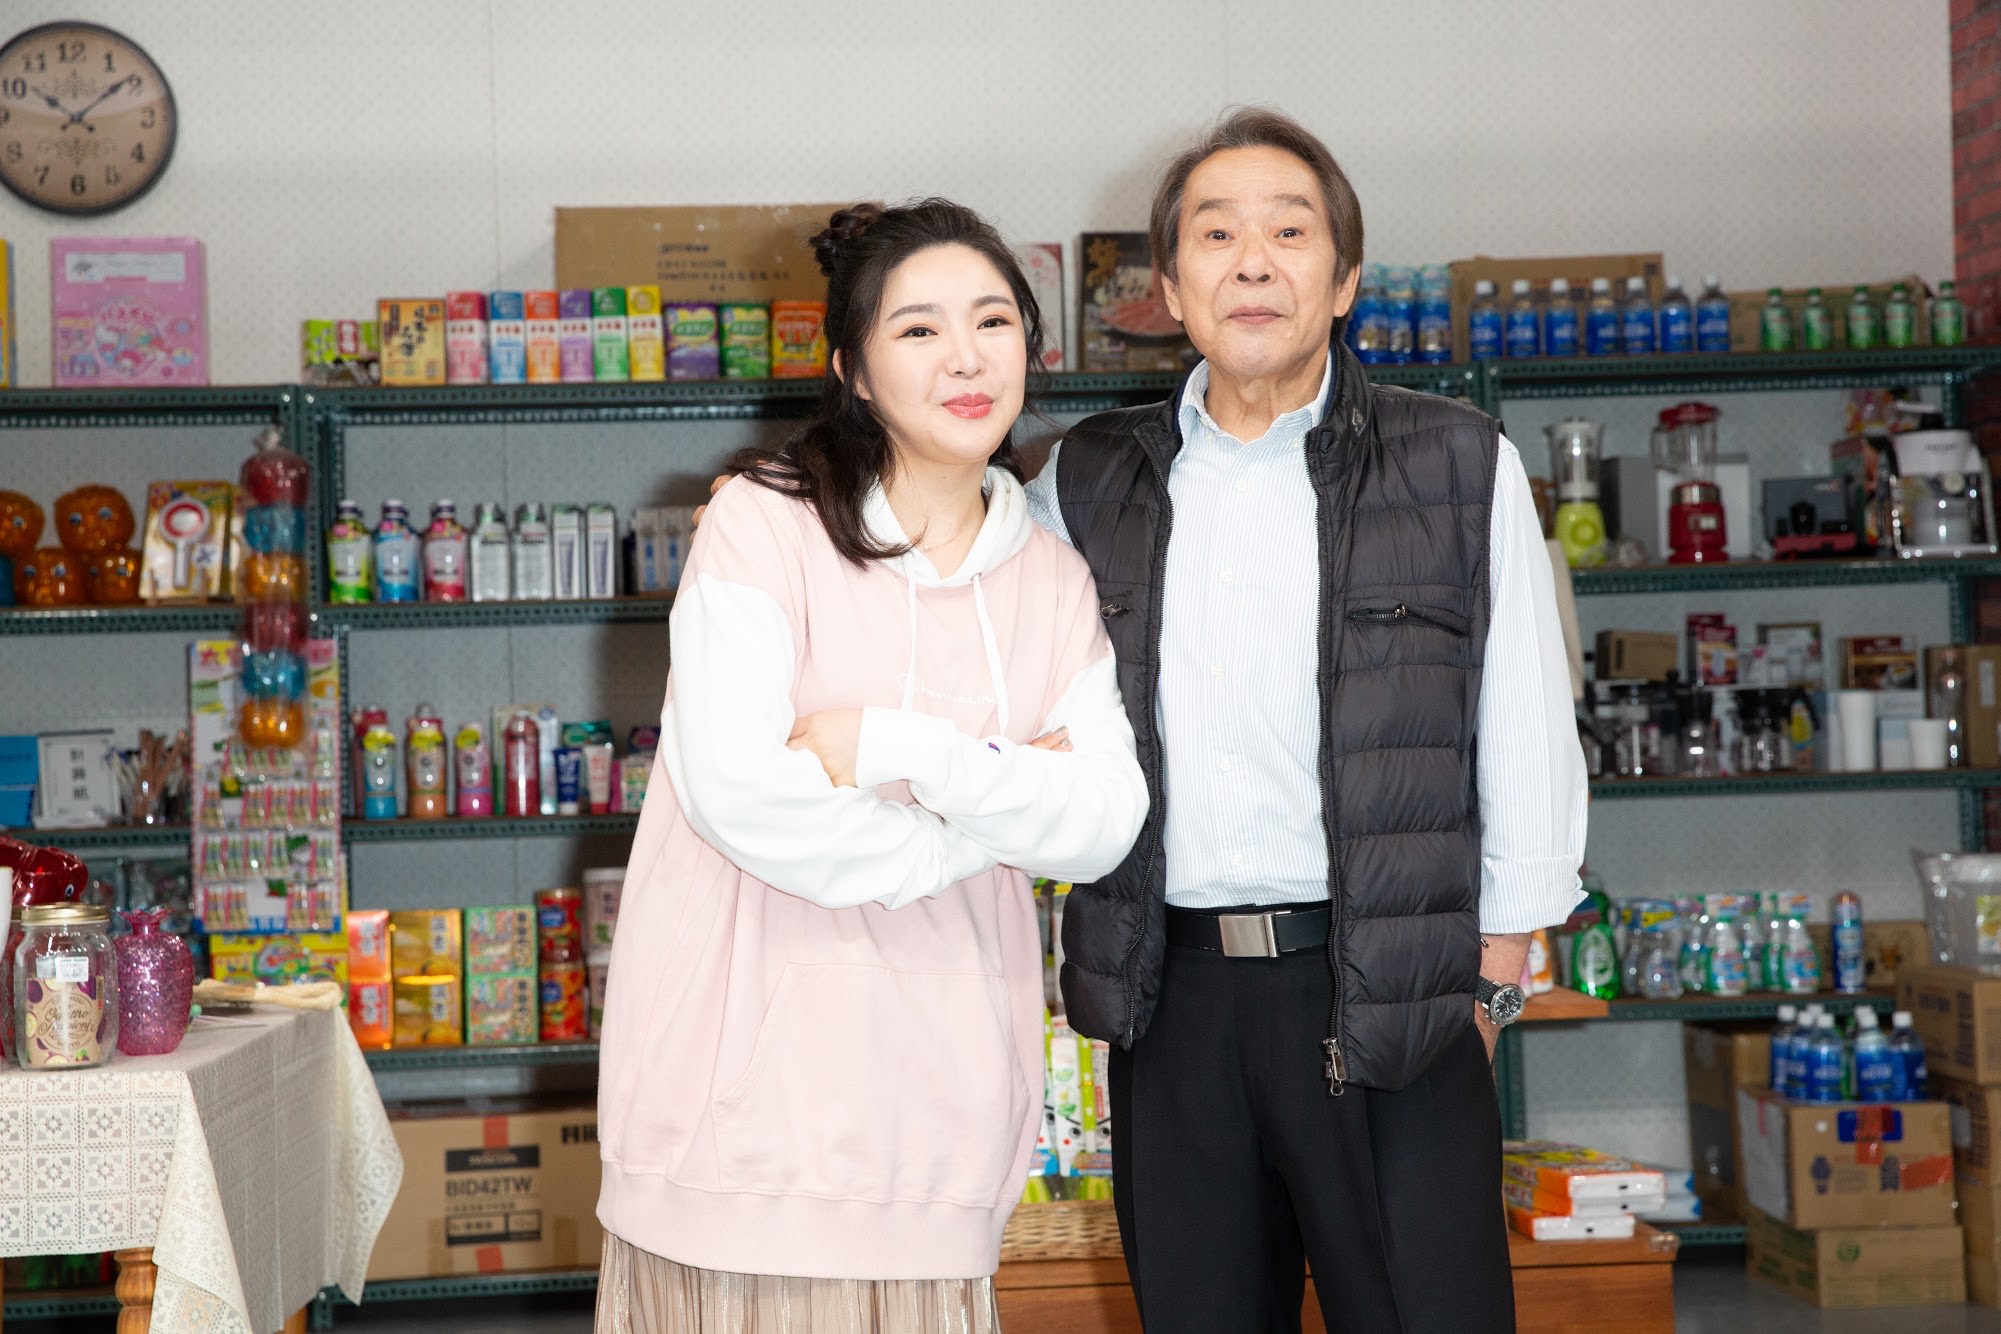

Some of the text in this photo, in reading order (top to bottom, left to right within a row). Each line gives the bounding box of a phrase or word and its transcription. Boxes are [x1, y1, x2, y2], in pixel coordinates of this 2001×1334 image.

[21, 52, 47, 74] 11
[57, 41, 86, 64] 12
[103, 53, 116, 73] 1
[1, 77, 28, 99] 10
[139, 105, 155, 129] 3
[130, 143, 145, 164] 4
[34, 164, 50, 186] 7
[70, 174, 87, 196] 6
[104, 165, 121, 186] 5
